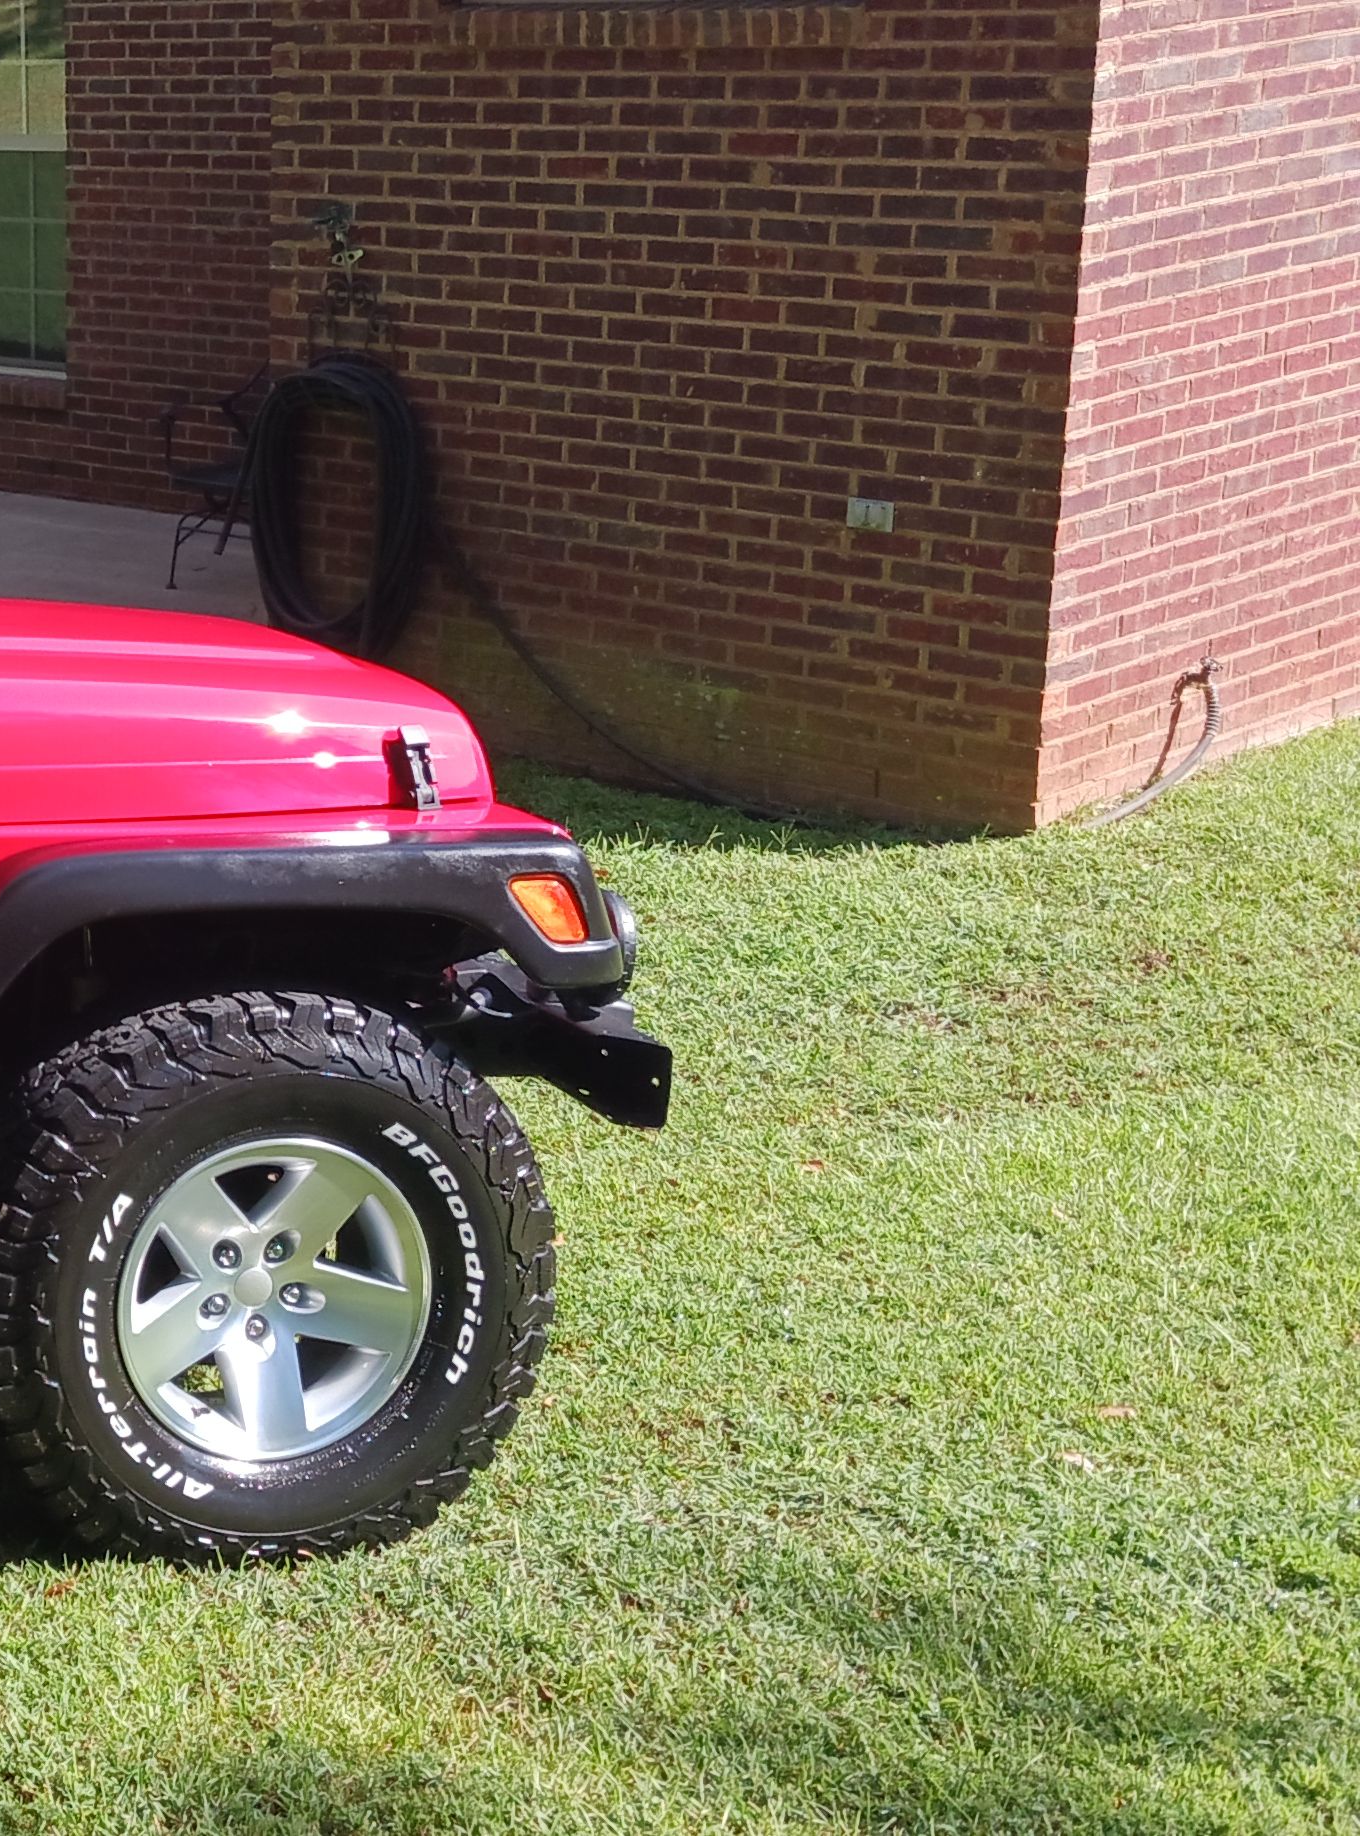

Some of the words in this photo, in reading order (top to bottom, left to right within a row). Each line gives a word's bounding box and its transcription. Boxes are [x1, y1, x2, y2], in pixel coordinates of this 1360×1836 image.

[88, 1192, 134, 1264] T/A
[381, 1120, 485, 1387] BFGoodrich
[77, 1287, 214, 1502] All-Terrain
